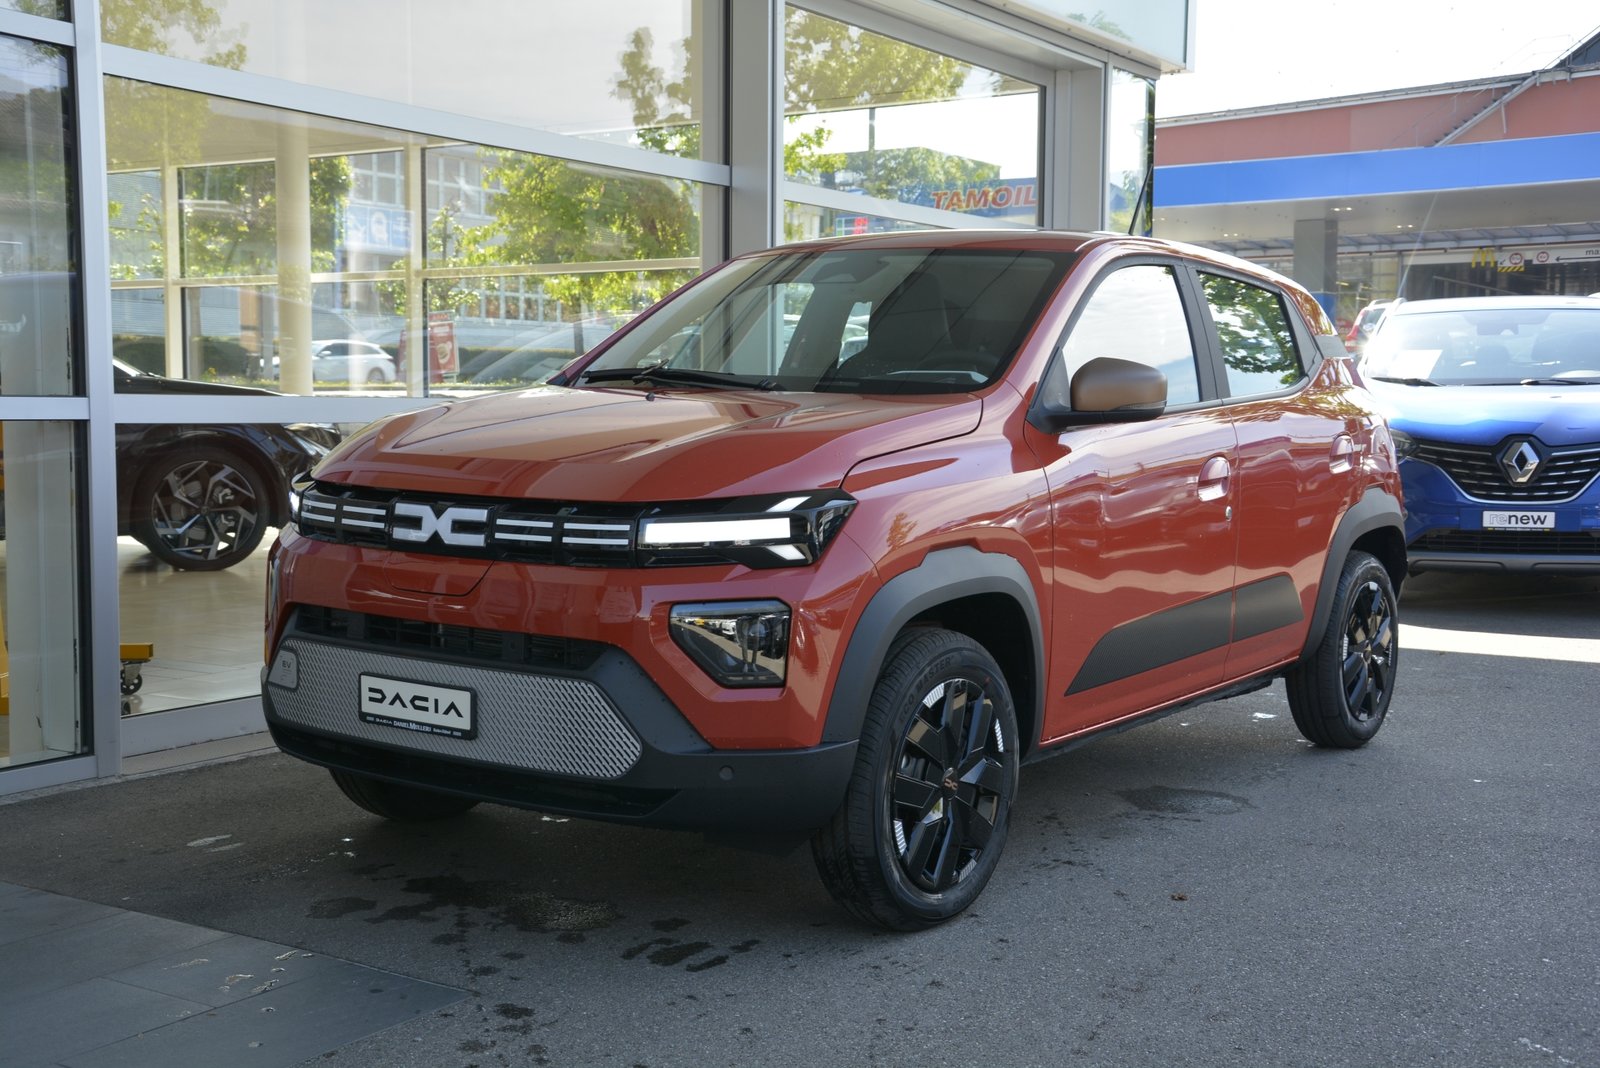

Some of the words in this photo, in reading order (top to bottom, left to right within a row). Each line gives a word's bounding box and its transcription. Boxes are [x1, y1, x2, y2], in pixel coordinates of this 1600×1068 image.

[932, 185, 1037, 212] TAMOIL
[1489, 513, 1547, 525] renew
[368, 686, 464, 718] DACIA
